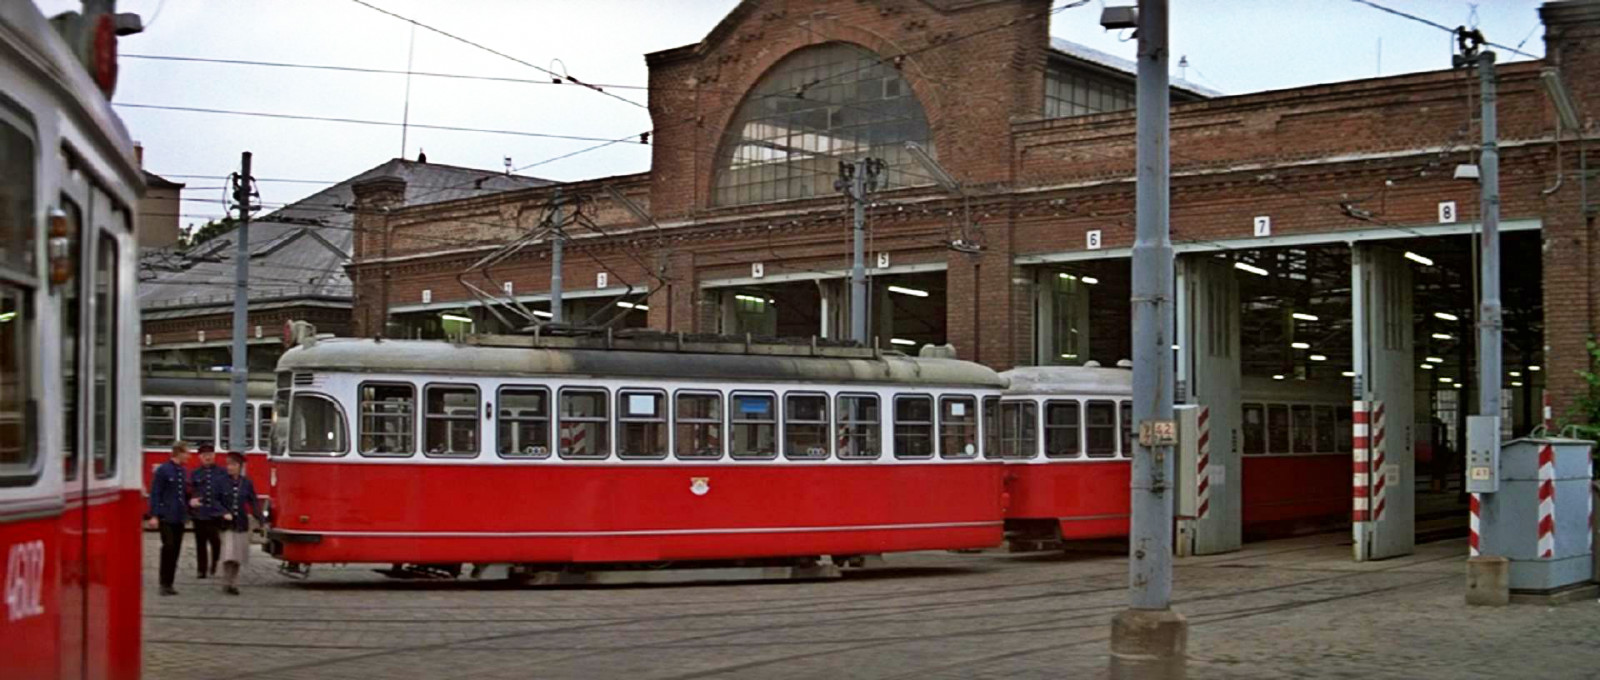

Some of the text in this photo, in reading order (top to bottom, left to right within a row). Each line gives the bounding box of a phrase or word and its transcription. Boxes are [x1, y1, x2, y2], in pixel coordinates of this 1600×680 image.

[1442, 204, 1452, 220] 8
[1258, 219, 1267, 234] 7
[1089, 233, 1098, 246] 6
